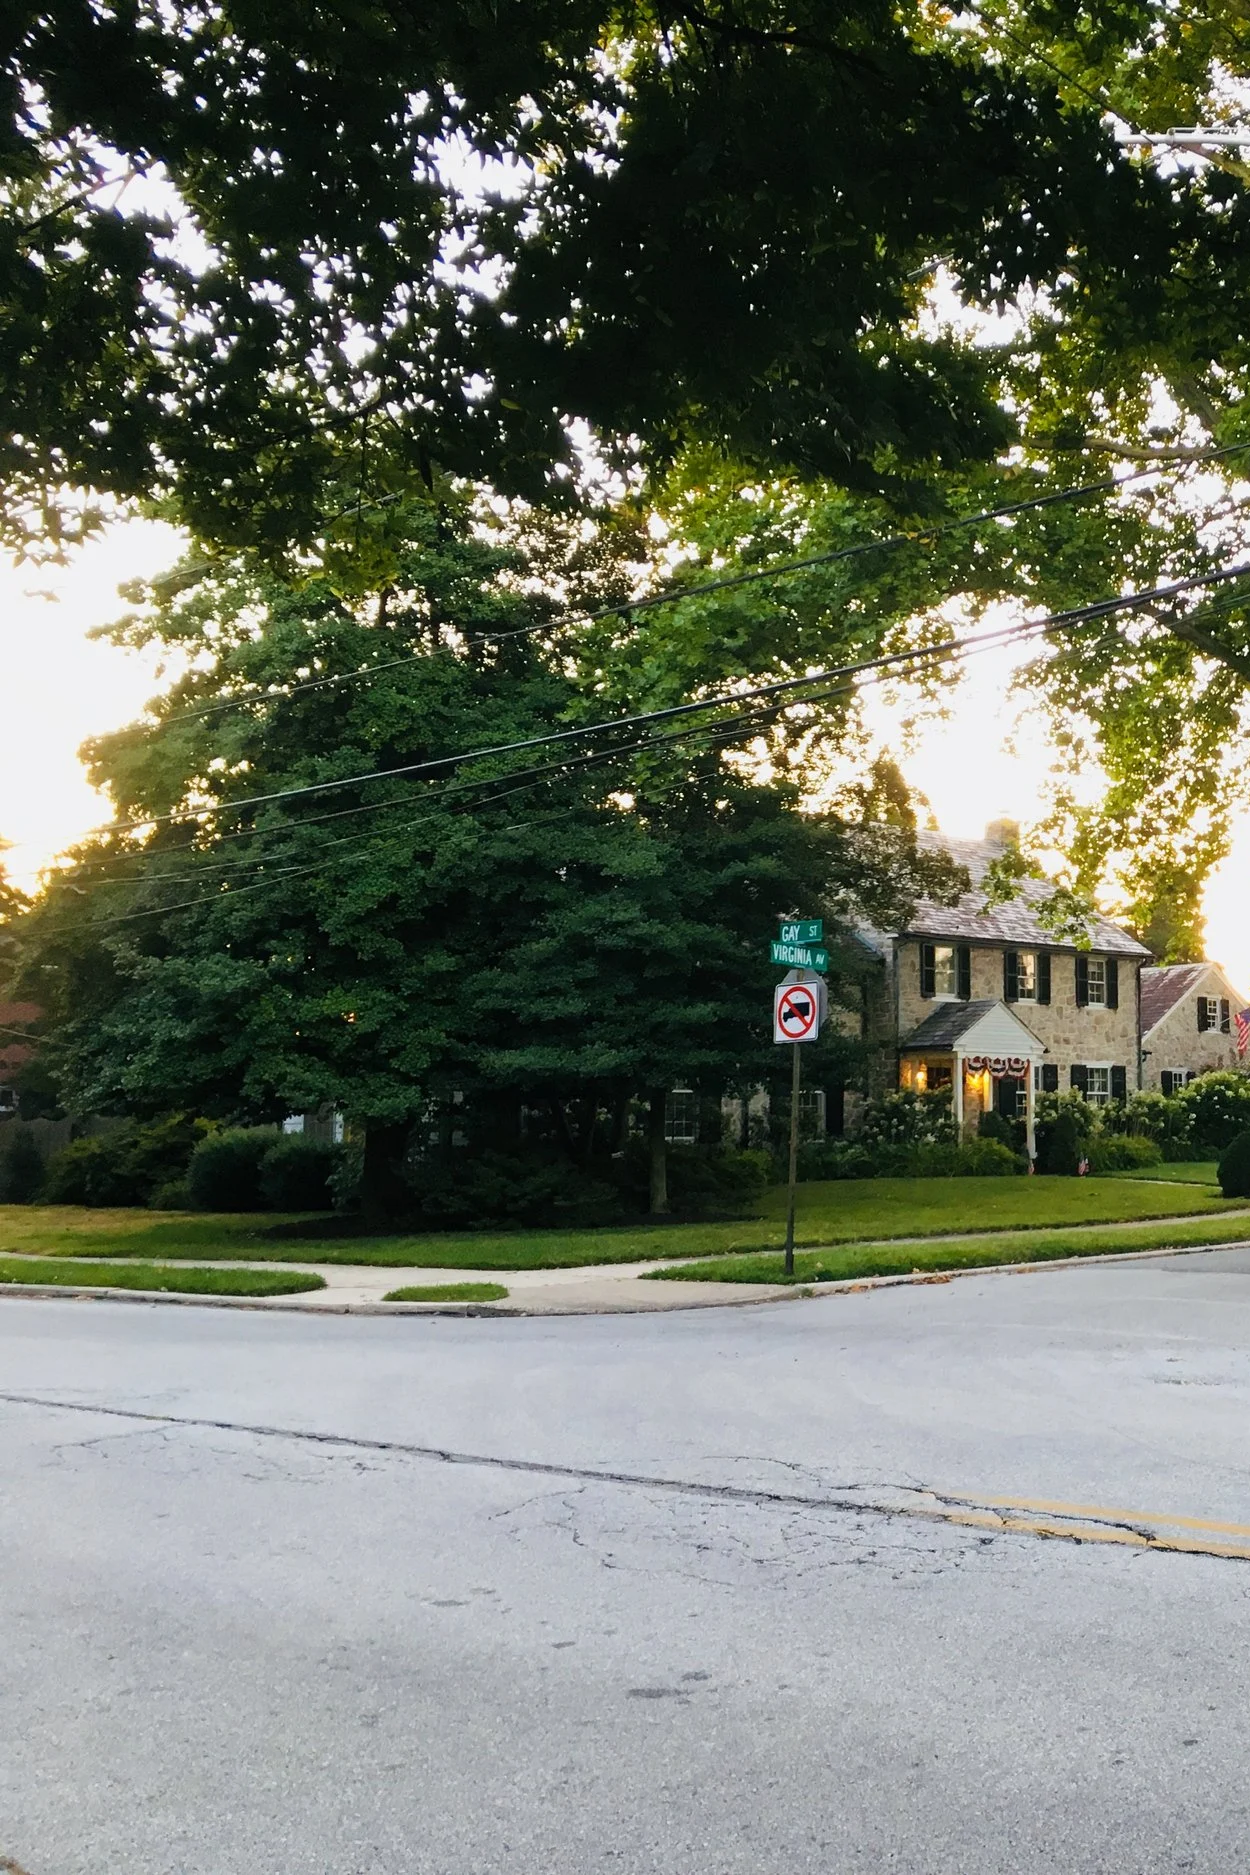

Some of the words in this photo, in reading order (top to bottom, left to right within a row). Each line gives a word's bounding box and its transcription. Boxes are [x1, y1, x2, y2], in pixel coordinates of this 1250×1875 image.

[782, 925, 800, 942] GAY
[809, 925, 818, 937] ST
[773, 944, 812, 966] VIRGINIA
[815, 953, 825, 965] AV
